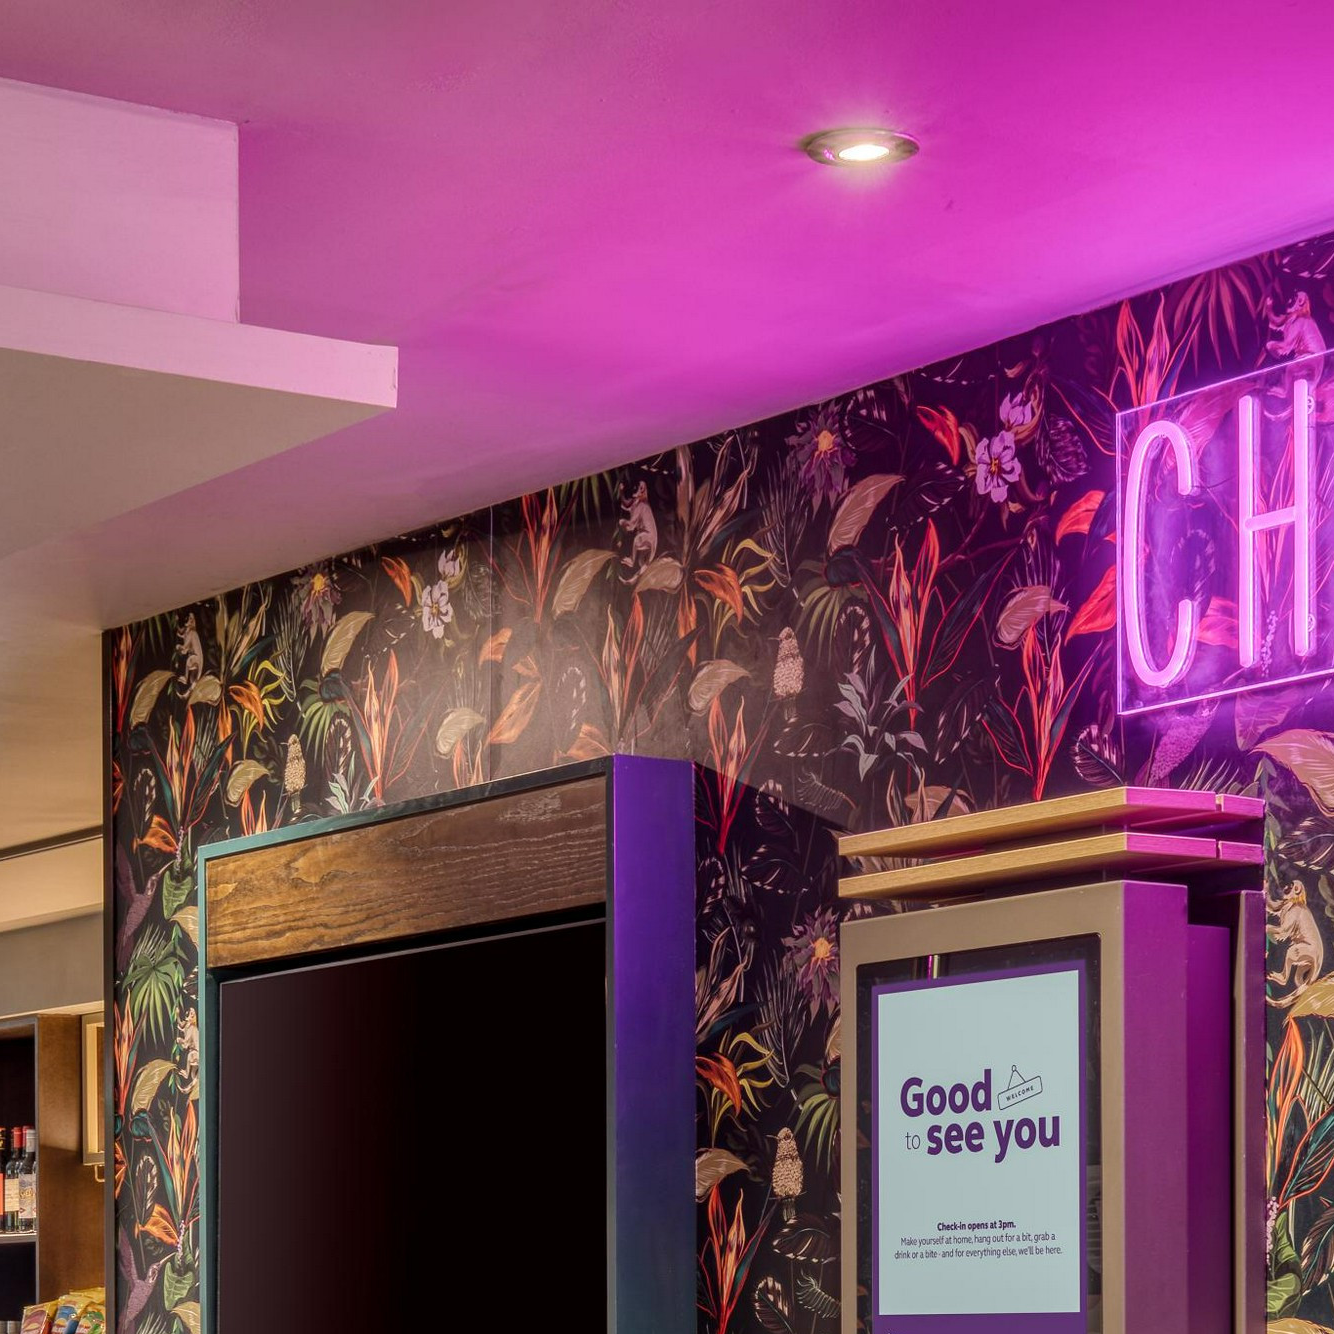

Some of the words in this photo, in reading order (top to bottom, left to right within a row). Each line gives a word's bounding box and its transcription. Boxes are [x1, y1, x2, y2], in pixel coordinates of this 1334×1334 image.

[900, 1068, 992, 1118] Good
[1005, 1085, 1035, 1102] WELCOME
[905, 1131, 921, 1150] to
[927, 1119, 985, 1156] see
[993, 1115, 1060, 1164] you
[937, 1222, 966, 1231] Check-in
[967, 1223, 989, 1231] opens
[989, 1221, 997, 1229] at
[998, 1220, 1016, 1230] 3pm.
[901, 1237, 917, 1246] Make
[918, 1236, 945, 1247] yourself
[945, 1236, 952, 1246] at
[953, 1236, 973, 1244] home,
[974, 1235, 991, 1245] hang
[992, 1234, 1004, 1242] out
[1005, 1233, 1015, 1242] for
[1021, 1232, 1033, 1242] bit,
[1033, 1232, 1050, 1243] grab
[893, 1250, 911, 1259] drink
[925, 1250, 938, 1258] bite
[941, 1249, 953, 1258] and
[955, 1248, 965, 1257] for
[965, 1248, 1001, 1258] everything
[1002, 1247, 1017, 1256] else,
[1035, 1246, 1044, 1254] be
[1045, 1246, 1063, 1254] here.
